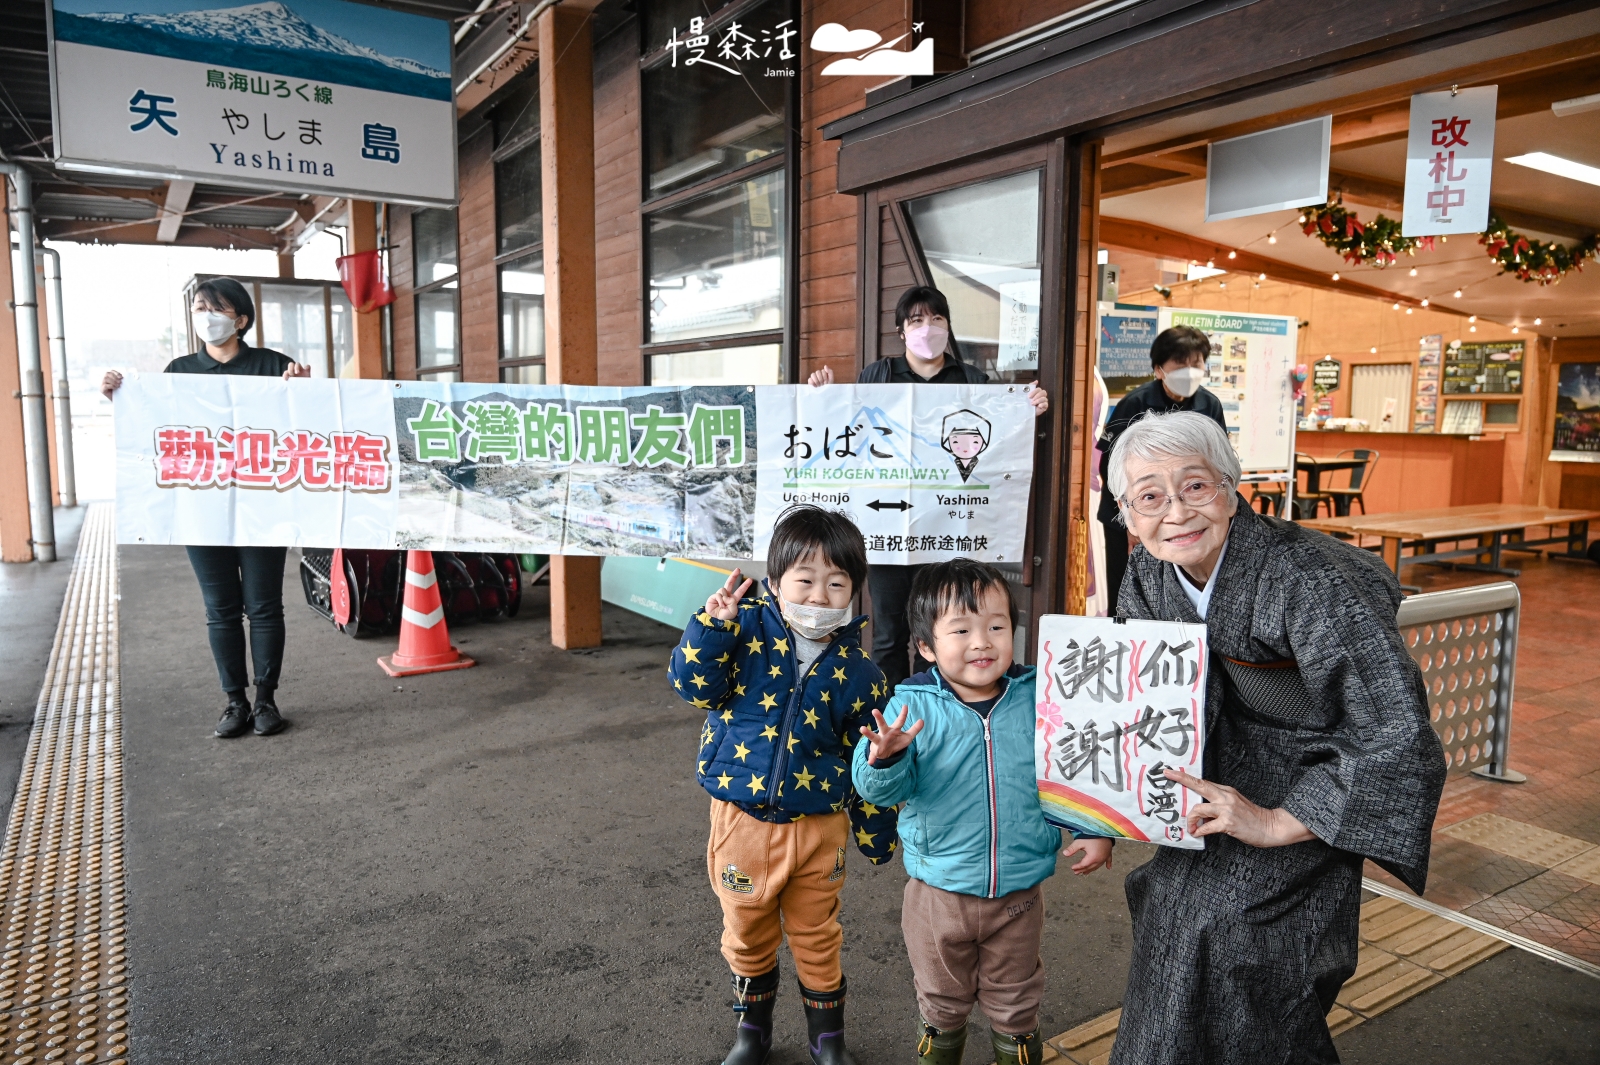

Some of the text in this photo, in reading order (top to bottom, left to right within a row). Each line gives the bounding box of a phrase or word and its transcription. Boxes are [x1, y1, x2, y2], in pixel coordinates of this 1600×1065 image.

[205, 68, 334, 105] 鳥海山ろく線
[221, 107, 324, 146] やしま
[210, 142, 336, 178] Yashima
[1426, 115, 1471, 217] 改札中
[1174, 315, 1213, 328] BULLETIN
[1214, 317, 1243, 329] BOARD
[410, 400, 744, 467] 台灣的朋友們
[783, 424, 894, 461] おばこ
[784, 467, 949, 481] YURI KOGEN RAILWAY
[936, 494, 990, 506] Yashima
[947, 510, 975, 520] やしま
